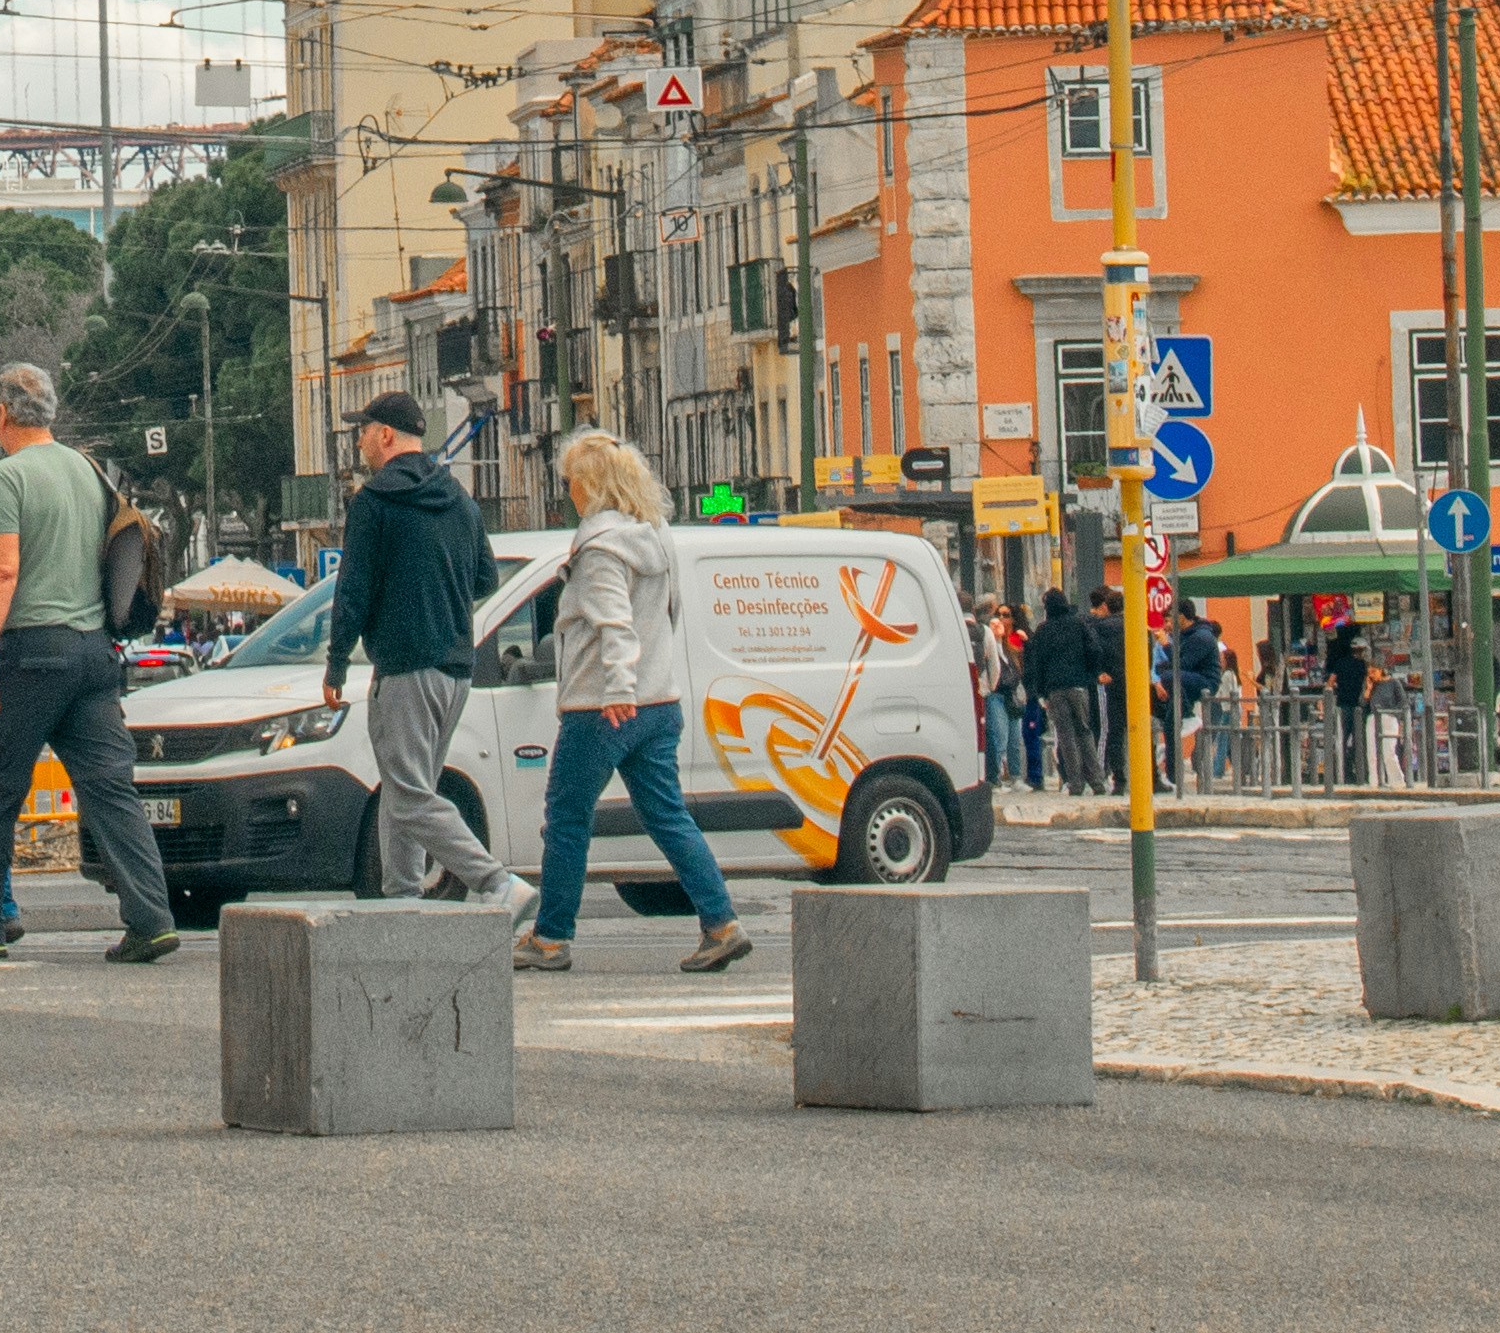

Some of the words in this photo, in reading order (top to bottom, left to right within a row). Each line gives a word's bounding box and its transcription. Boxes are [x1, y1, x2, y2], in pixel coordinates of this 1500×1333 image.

[670, 214, 689, 232] 10
[149, 433, 164, 451] S
[713, 573, 760, 589] Centro
[764, 571, 820, 589] Técnico
[208, 585, 283, 606] SAGRES
[1148, 591, 1172, 613] TOP
[713, 597, 731, 615] de
[736, 597, 829, 618] Desinfecções
[756, 626, 767, 637] 21
[787, 626, 798, 637] 22
